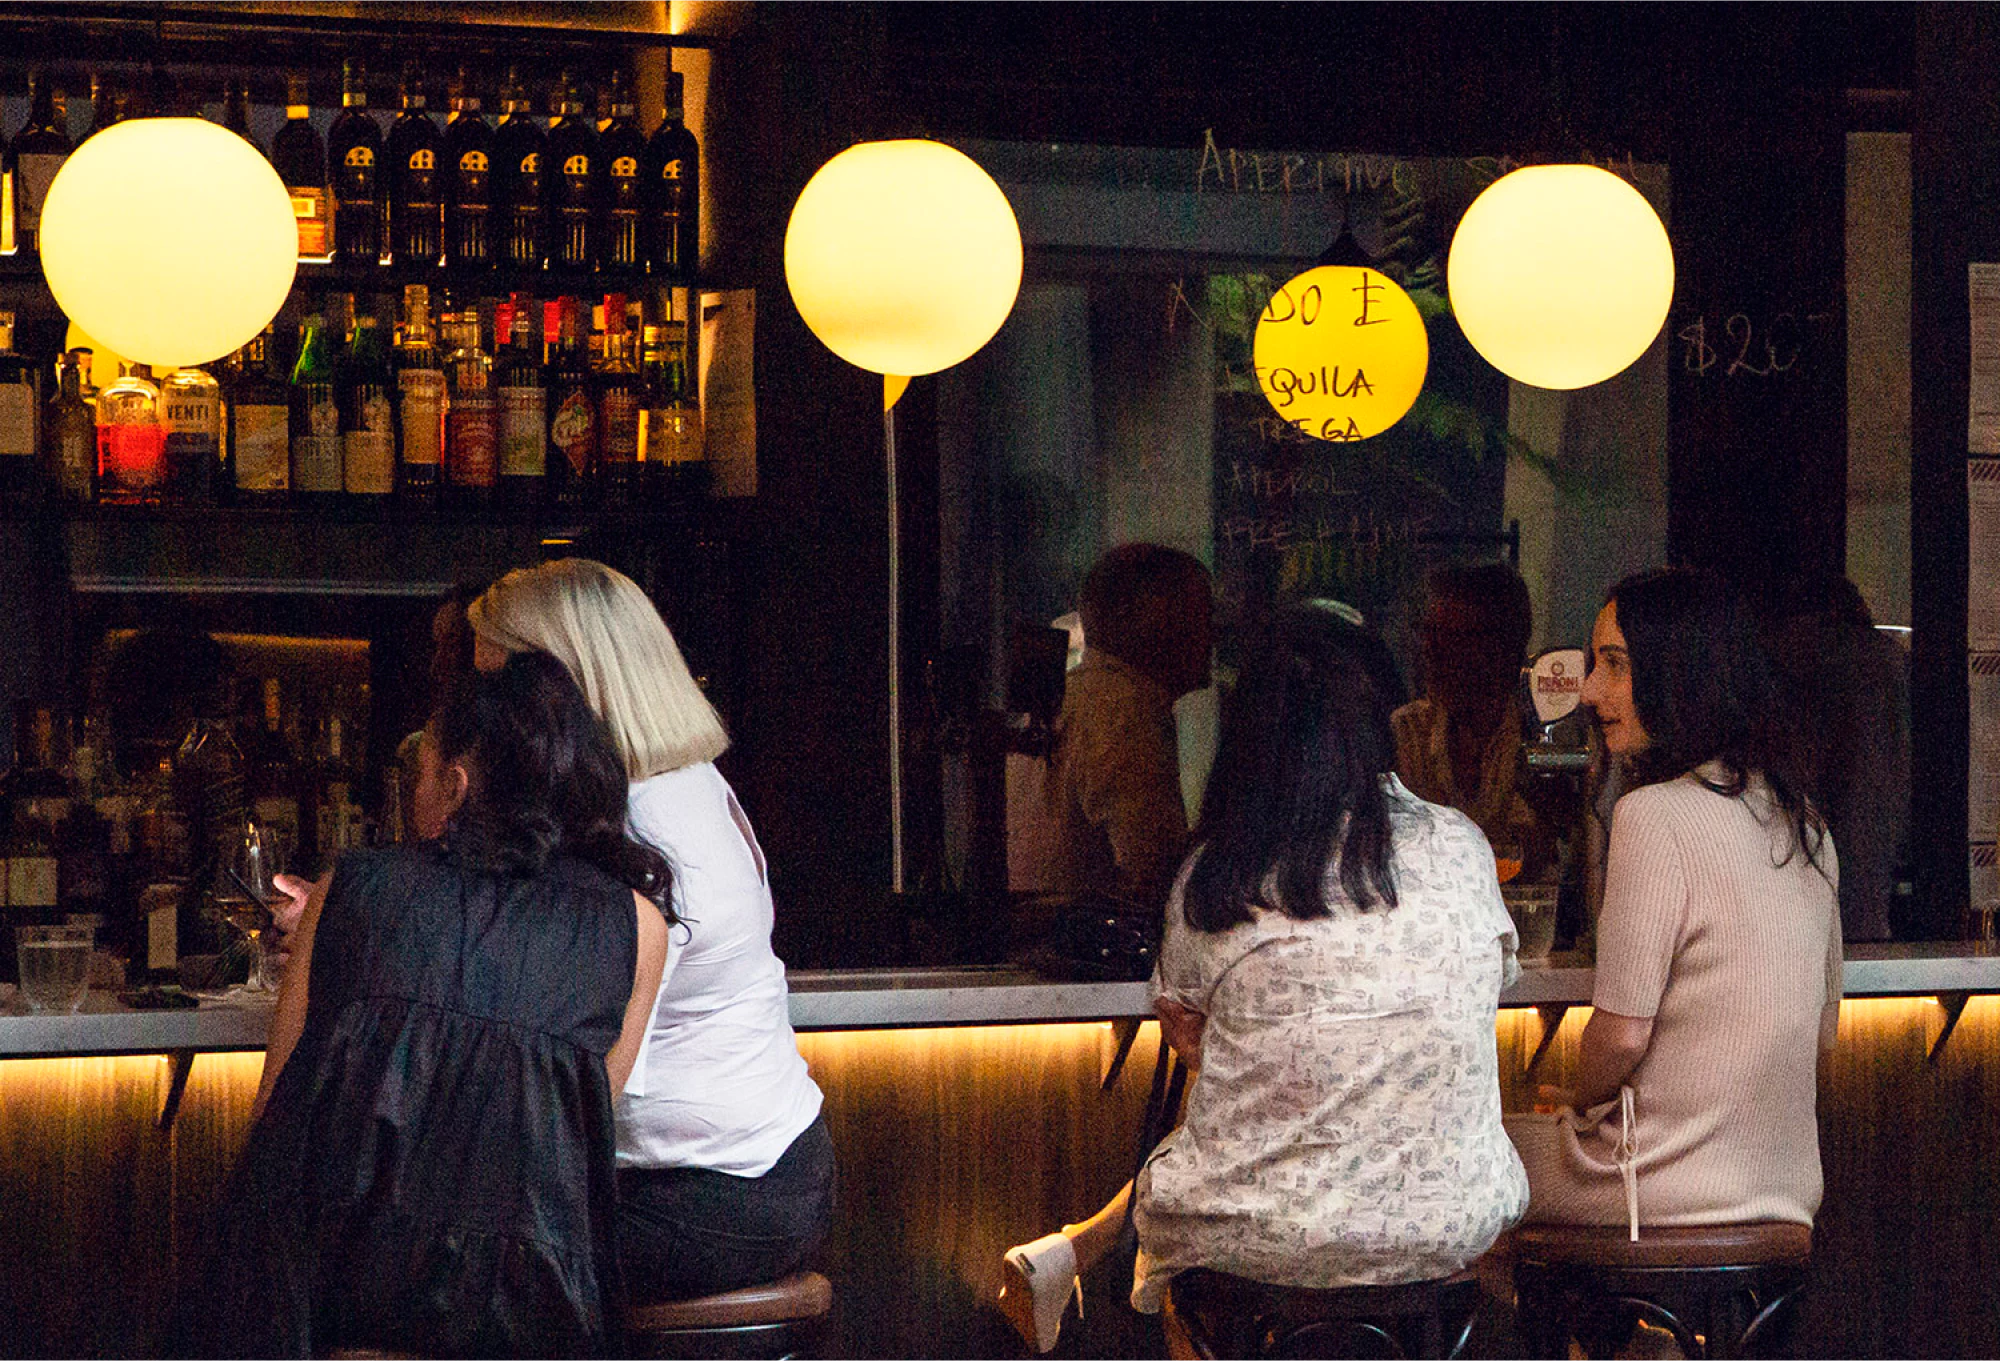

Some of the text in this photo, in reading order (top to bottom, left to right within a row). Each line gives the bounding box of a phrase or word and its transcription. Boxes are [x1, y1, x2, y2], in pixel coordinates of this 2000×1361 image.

[1352, 272, 1393, 327] E
[165, 404, 209, 421] VENTI
[1538, 675, 1579, 688] PERONI
